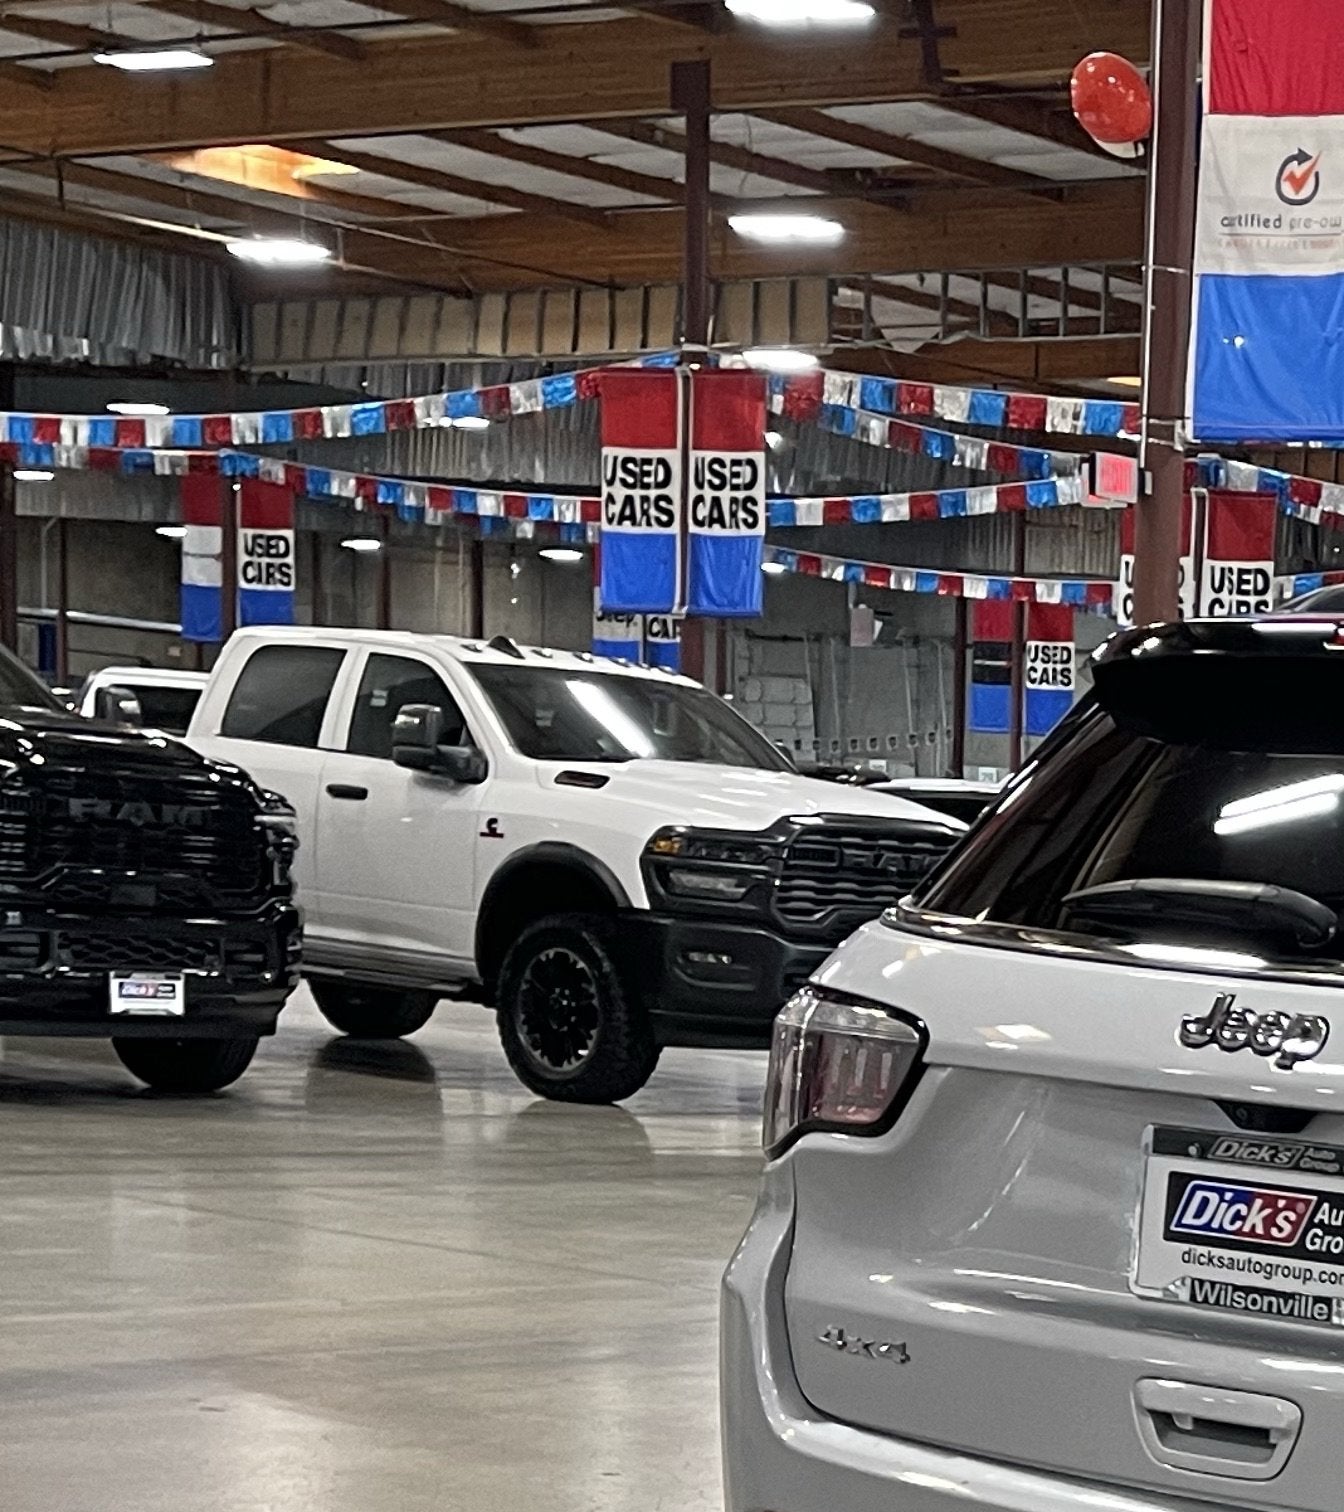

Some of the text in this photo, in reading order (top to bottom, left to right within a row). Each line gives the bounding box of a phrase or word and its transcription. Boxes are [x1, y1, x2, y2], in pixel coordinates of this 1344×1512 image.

[604, 455, 672, 490] USED
[694, 457, 758, 491] USED
[604, 492, 674, 528] CARS
[692, 494, 759, 529] CARS
[244, 533, 290, 559] USED
[1210, 565, 1270, 596] USED
[1027, 644, 1072, 665] USED
[1179, 991, 1331, 1071] Jeep
[1213, 1139, 1296, 1166] Dick's
[1303, 1147, 1336, 1161] Auto
[1181, 1189, 1297, 1239] Dick's
[1193, 1279, 1330, 1321] Wilsonville
